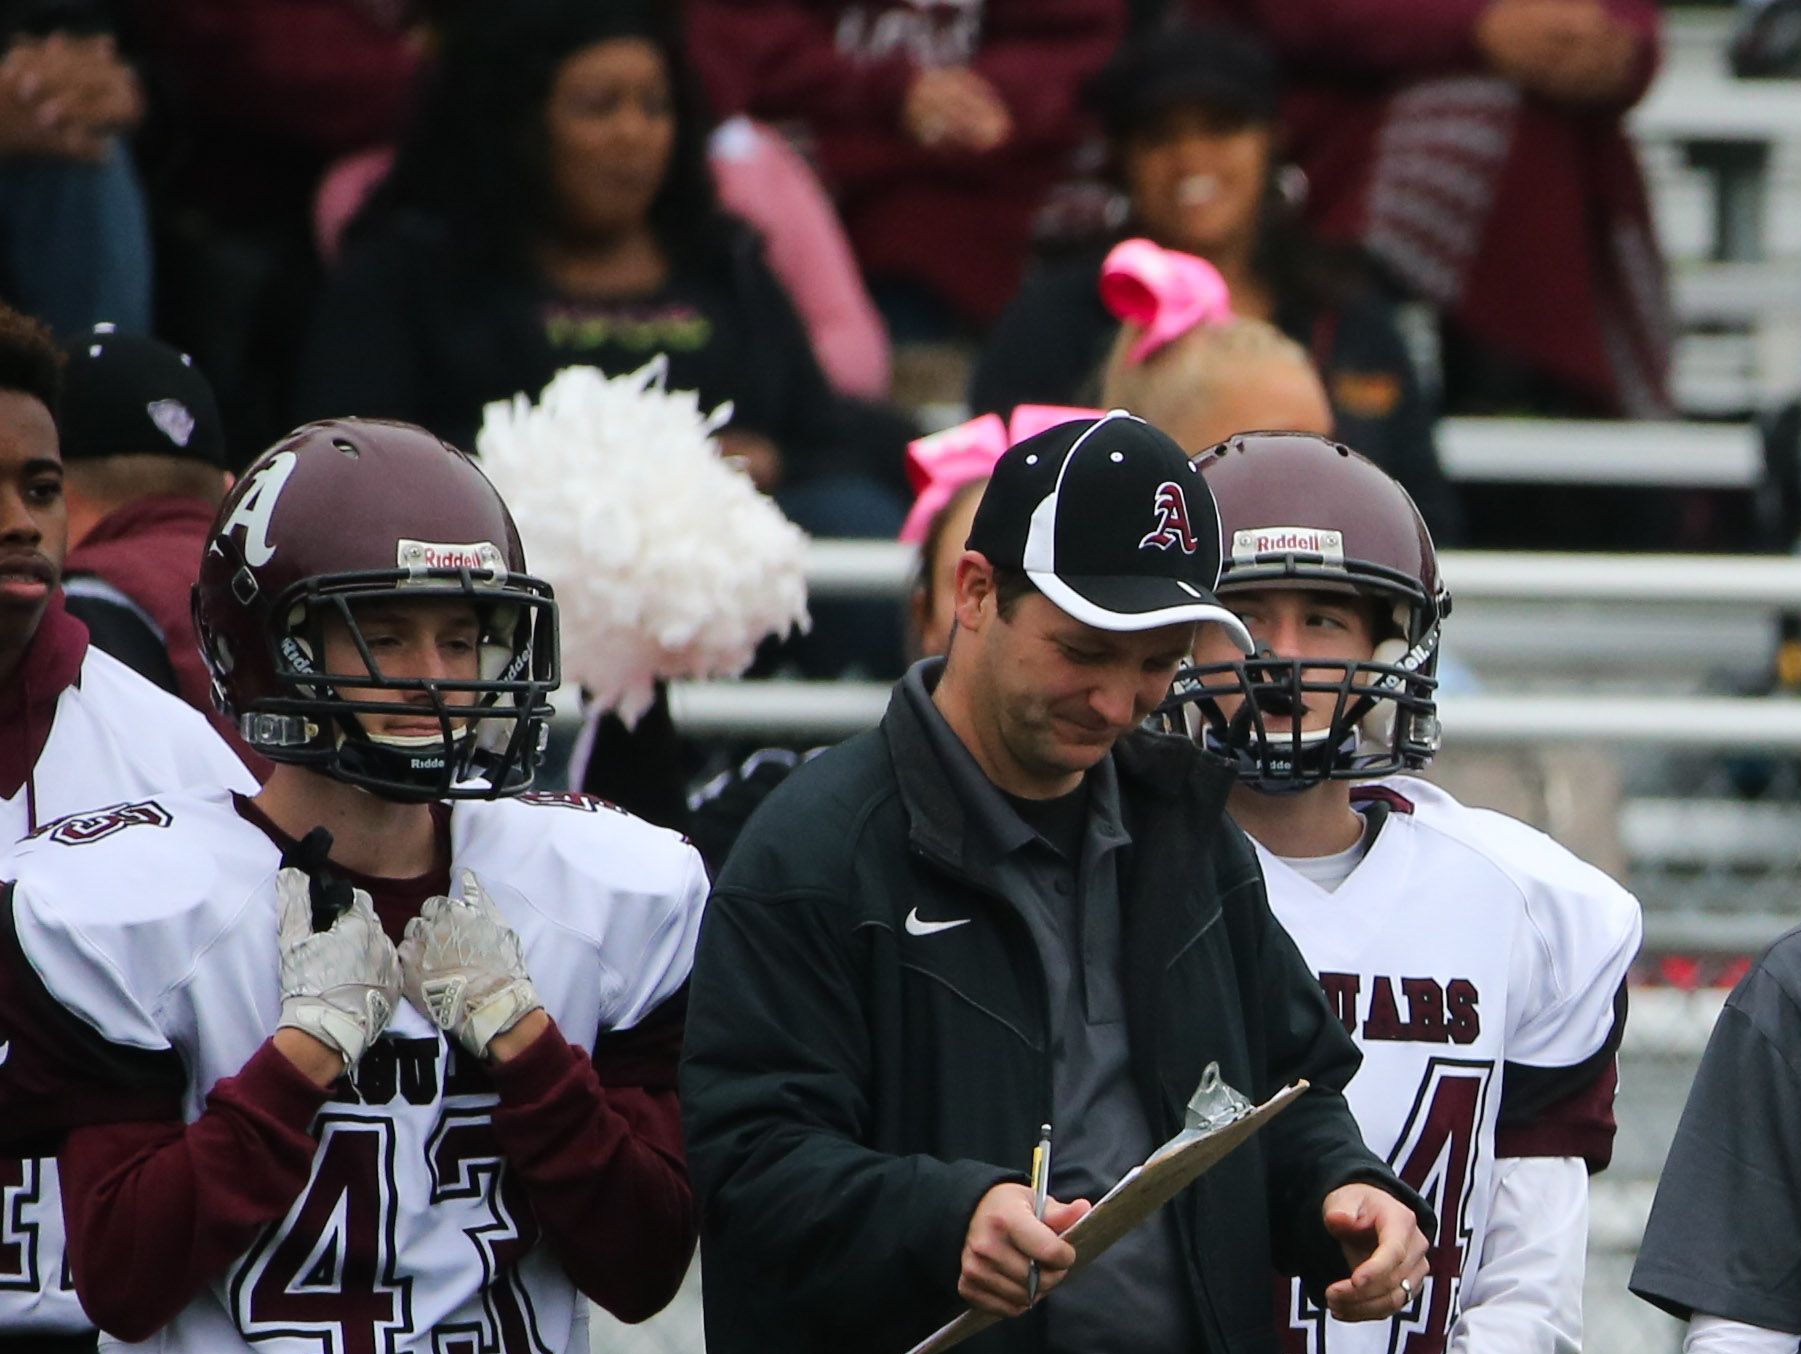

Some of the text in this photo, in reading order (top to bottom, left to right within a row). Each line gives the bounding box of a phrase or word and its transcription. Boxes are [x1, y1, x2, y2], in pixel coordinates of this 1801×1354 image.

[208, 450, 298, 568] A
[1138, 481, 1199, 555] A
[1256, 532, 1321, 552] Riddell
